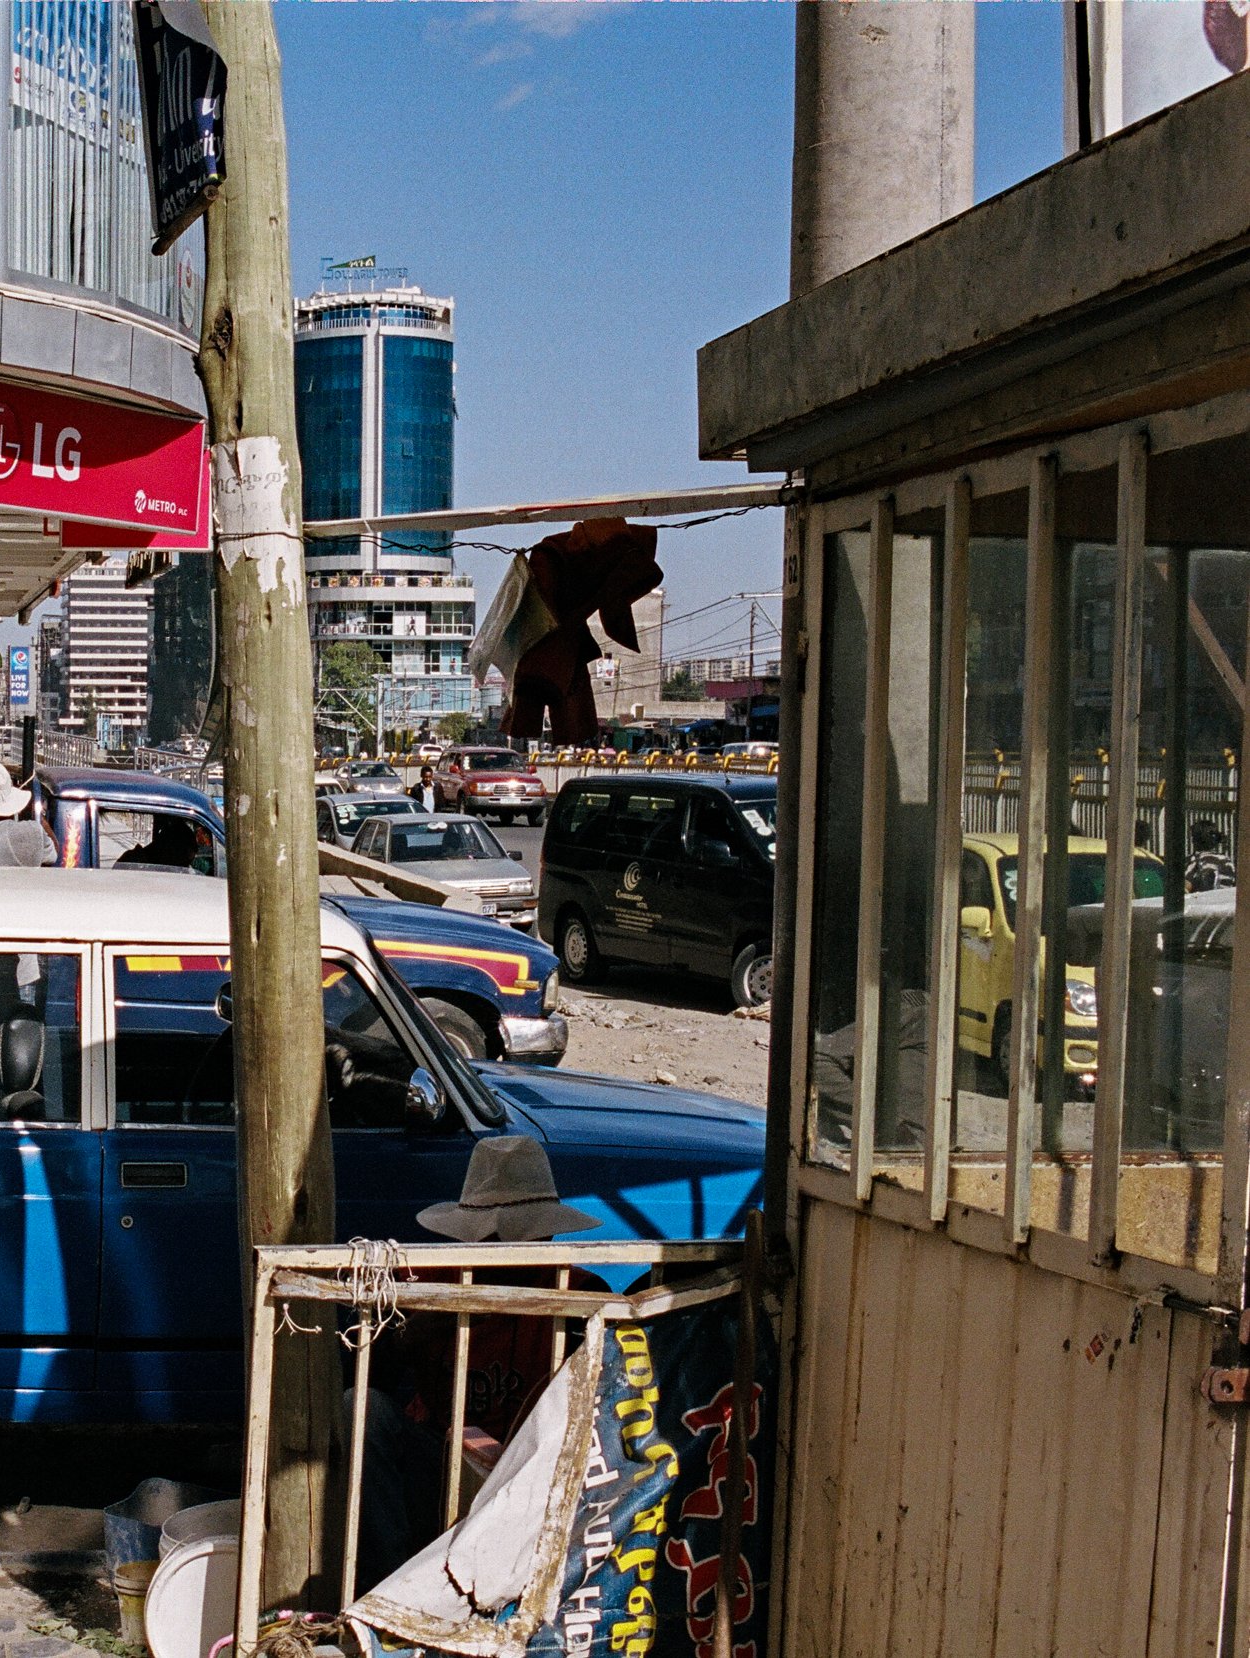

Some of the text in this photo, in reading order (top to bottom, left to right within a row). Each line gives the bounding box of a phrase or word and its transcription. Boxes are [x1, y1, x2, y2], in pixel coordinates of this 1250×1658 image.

[31, 422, 82, 483] LG
[147, 498, 188, 517] METRO PLC
